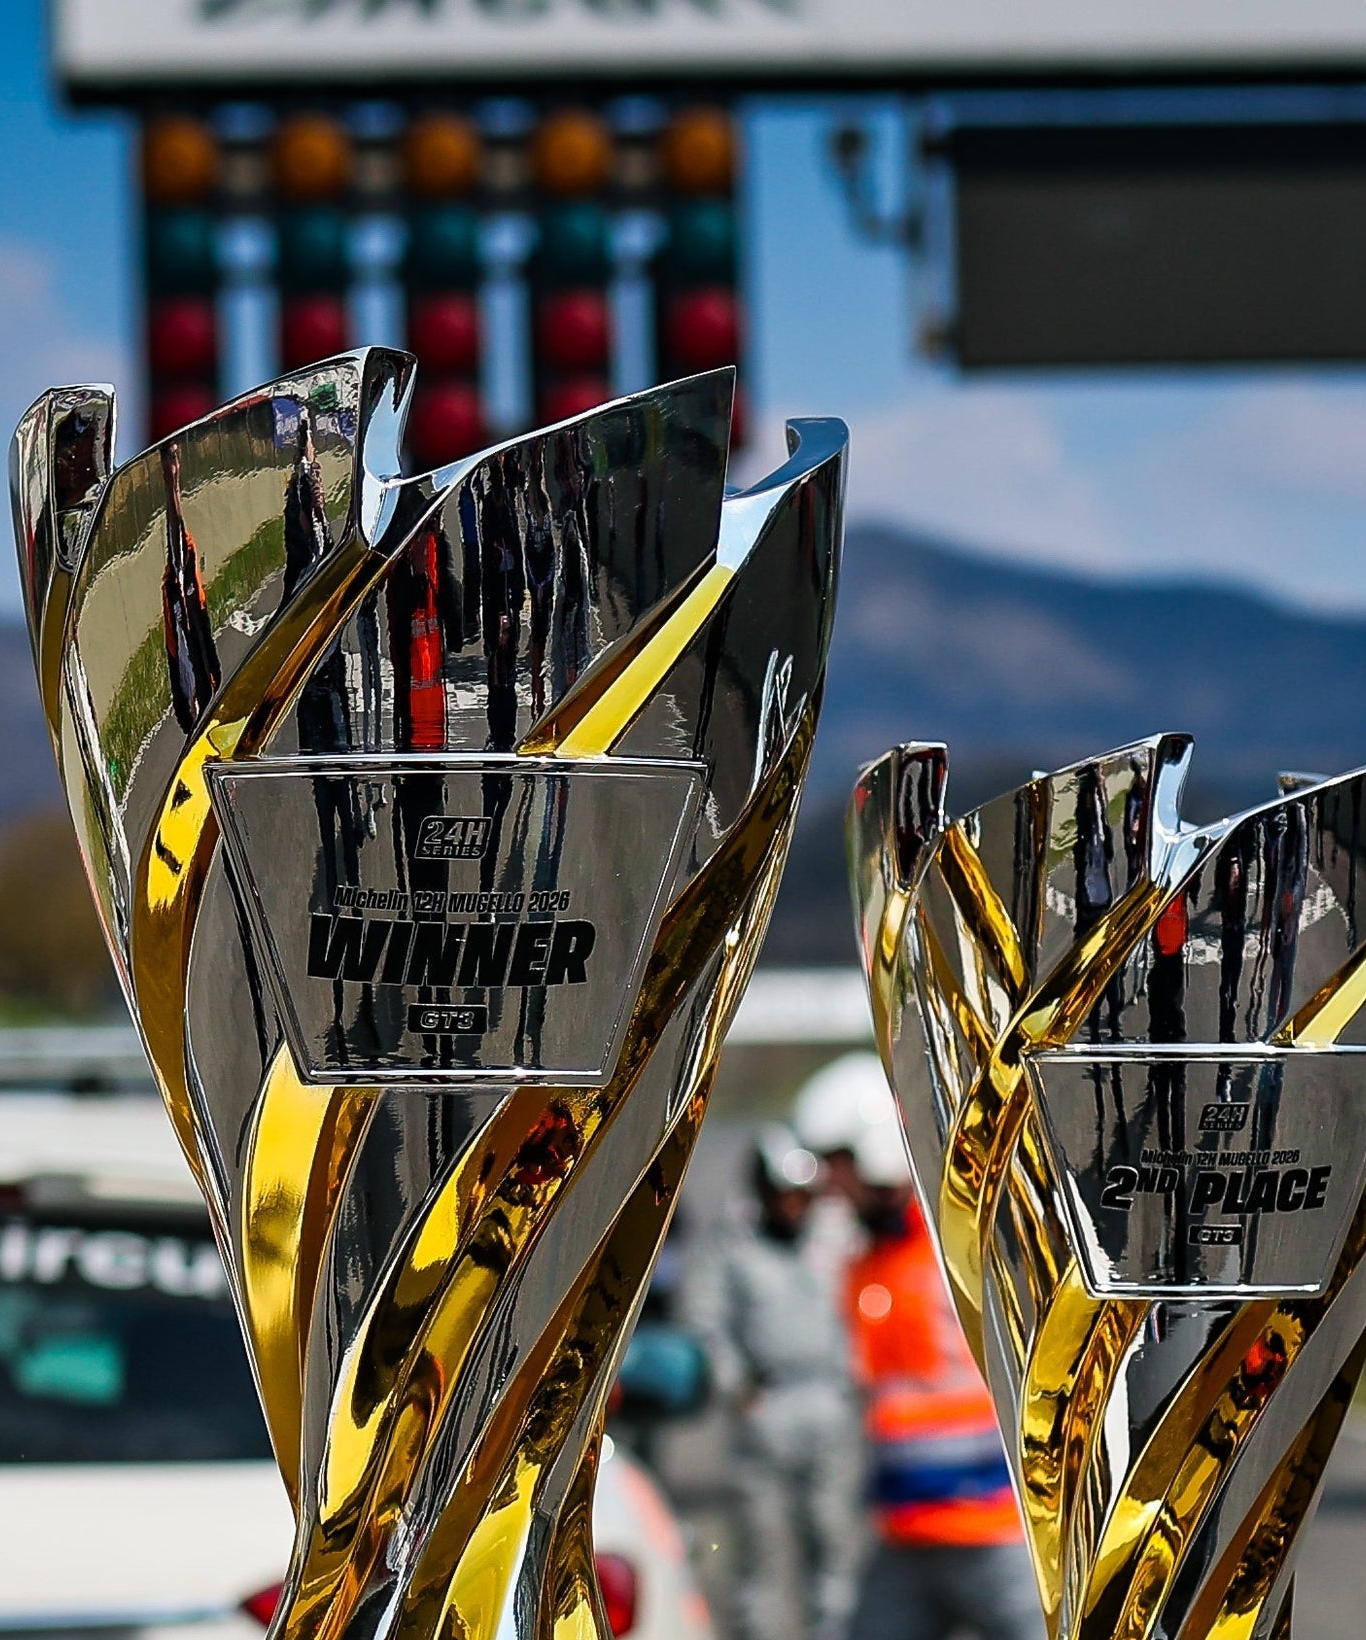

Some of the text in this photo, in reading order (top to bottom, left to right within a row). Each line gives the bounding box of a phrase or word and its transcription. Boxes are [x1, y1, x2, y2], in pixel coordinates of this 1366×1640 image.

[423, 821, 487, 846] 24H
[334, 886, 570, 913] Michelin 12H MUGELLO 2026
[306, 912, 596, 989] WINNER
[420, 1010, 475, 1030] GT3
[1205, 1106, 1246, 1122] 24H
[1101, 1165, 1331, 1215] 2ND PLACE
[1199, 1229, 1235, 1243] GT3
